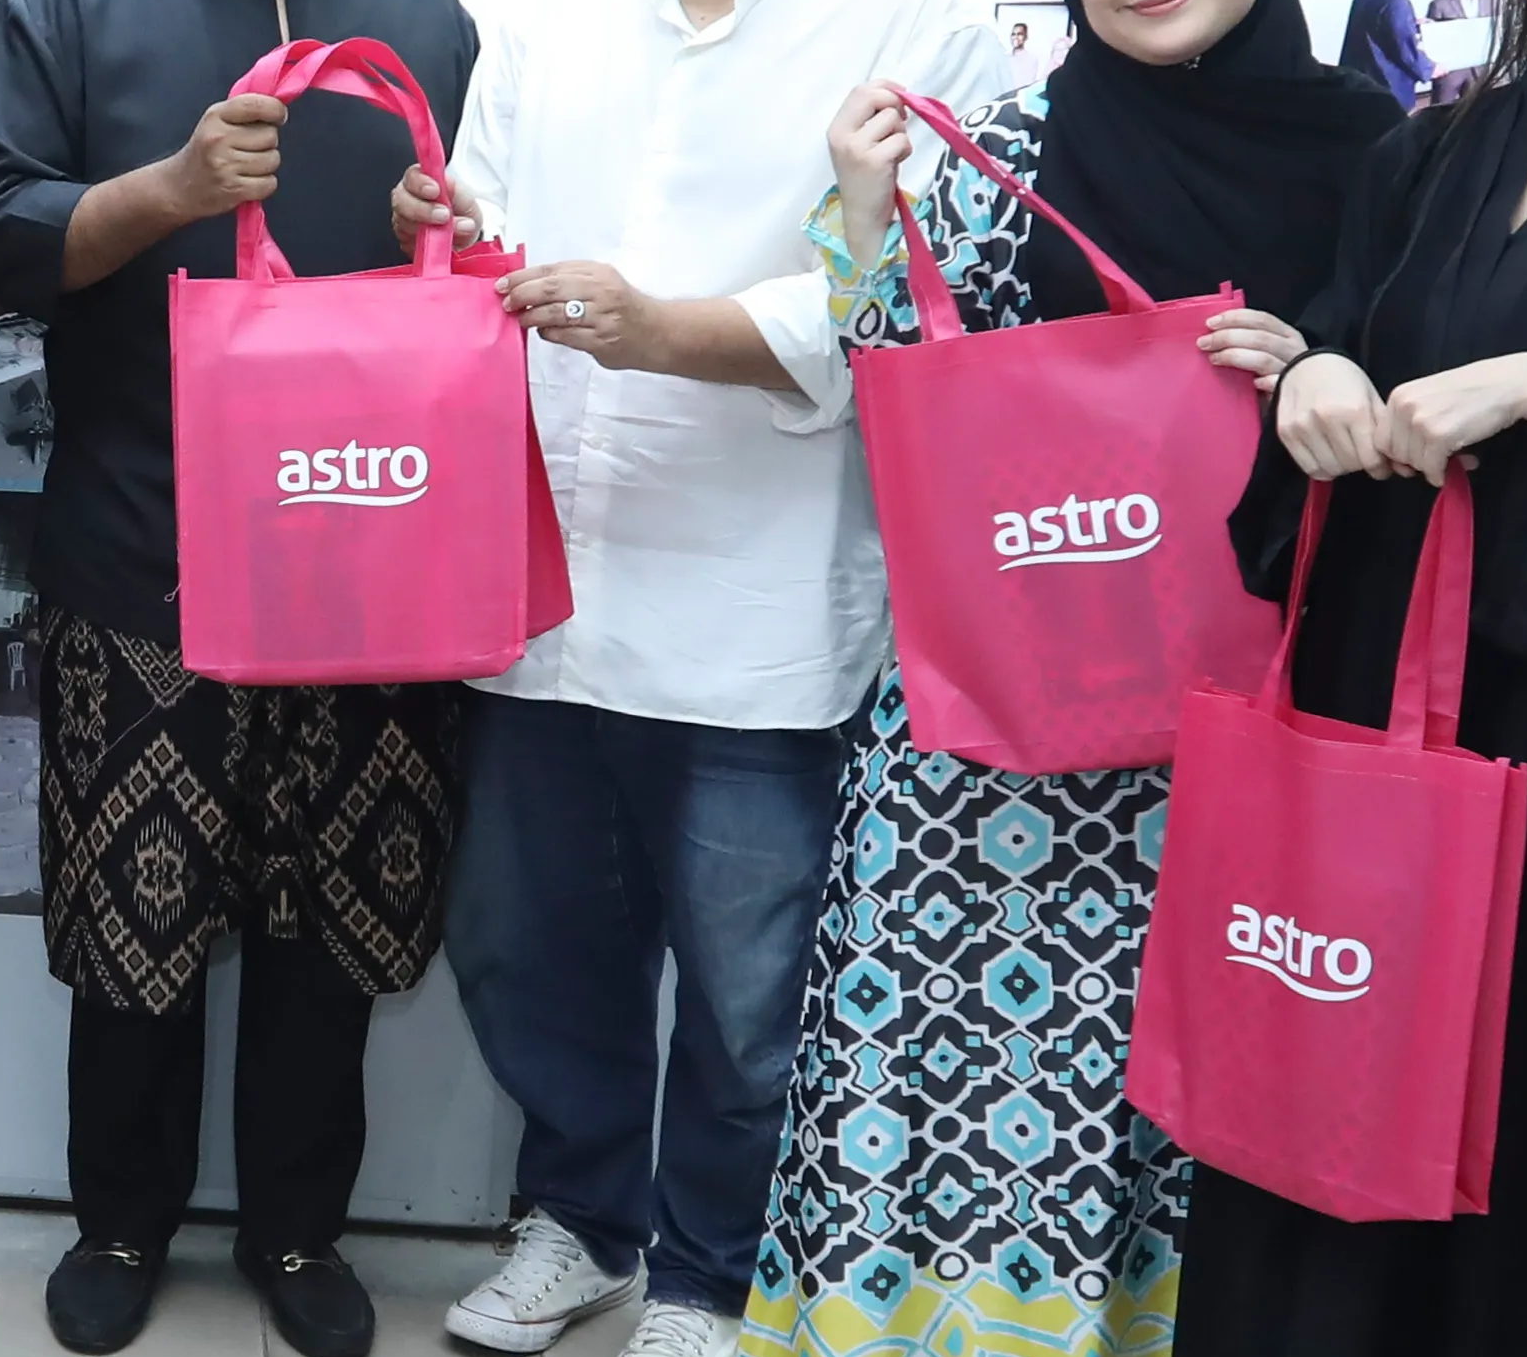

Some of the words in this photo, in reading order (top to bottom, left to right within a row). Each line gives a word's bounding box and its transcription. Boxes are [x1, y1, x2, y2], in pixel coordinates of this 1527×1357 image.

[276, 439, 429, 493] astro
[993, 493, 1160, 556] astro
[1227, 903, 1372, 986] astro
